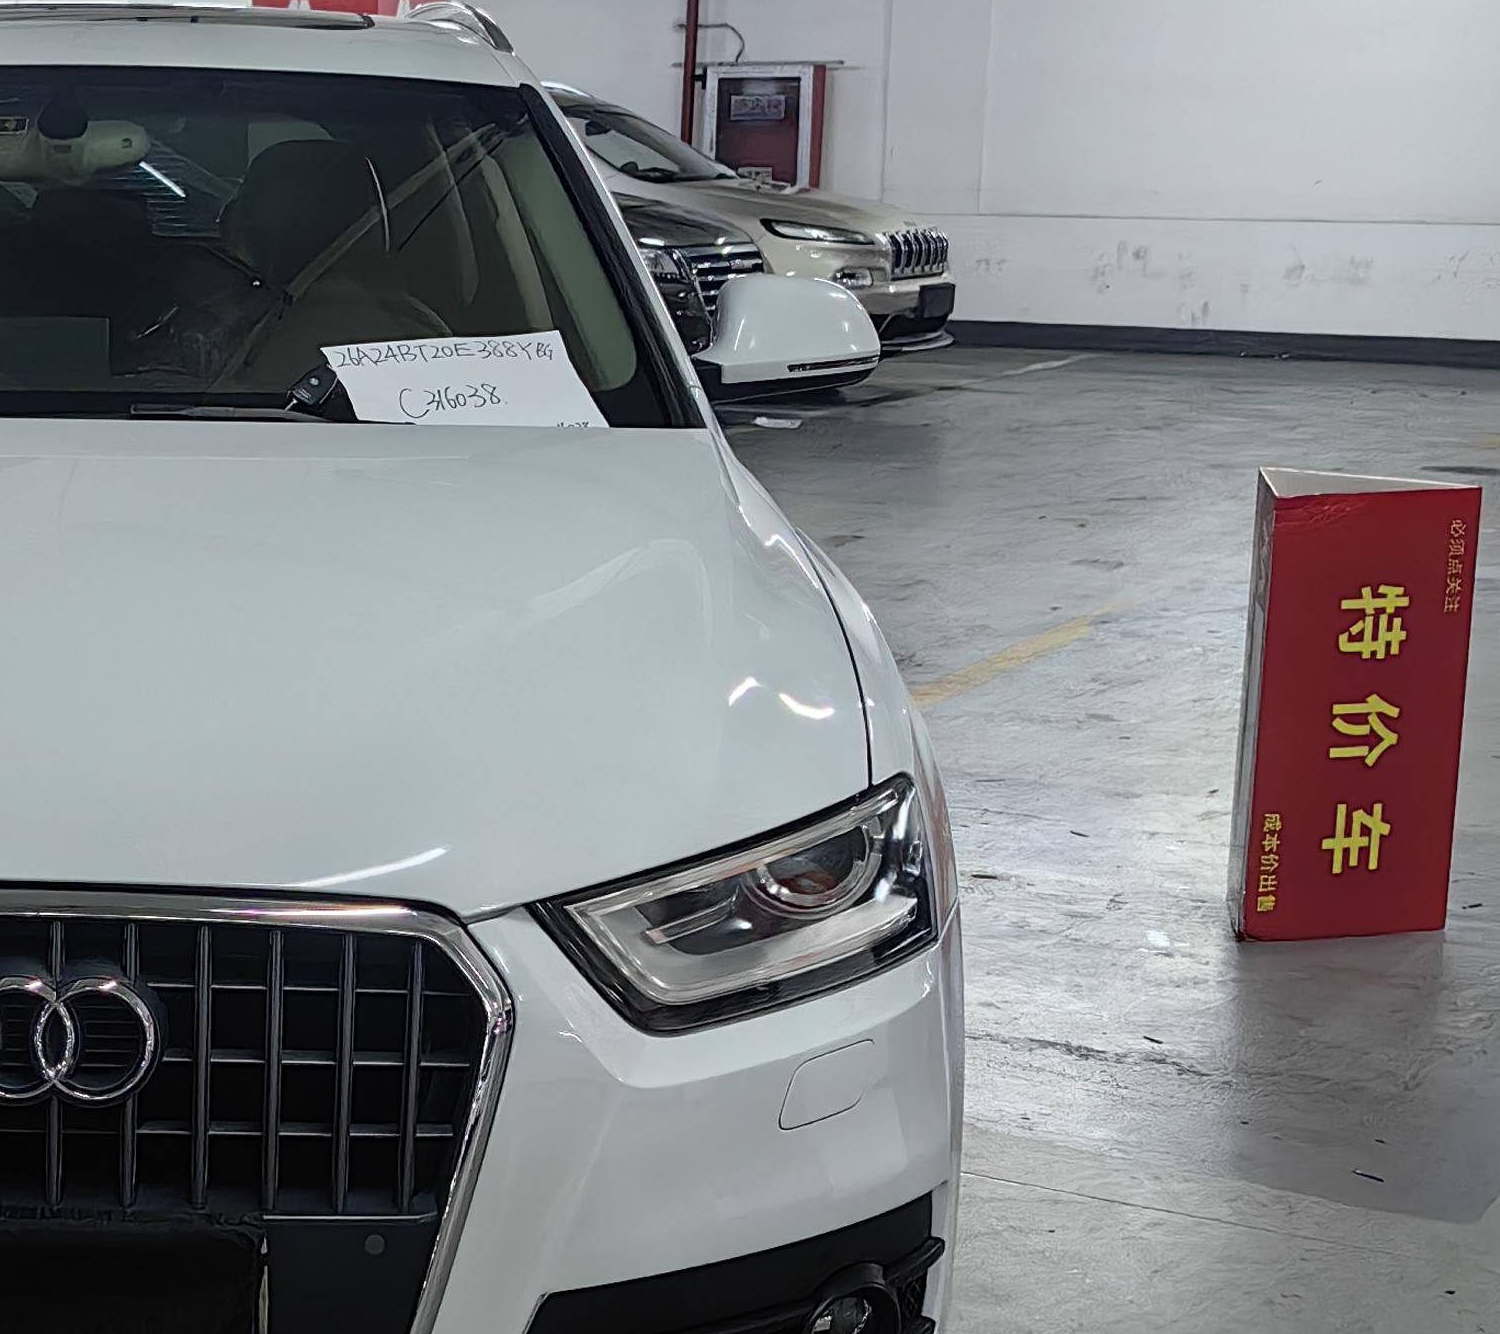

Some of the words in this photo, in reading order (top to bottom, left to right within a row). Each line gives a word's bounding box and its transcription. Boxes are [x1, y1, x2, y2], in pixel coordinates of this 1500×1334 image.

[1443, 518, 1467, 614] 必须点关注
[1320, 583, 1410, 875] 特价车
[1257, 812, 1282, 912] 成本价出售
